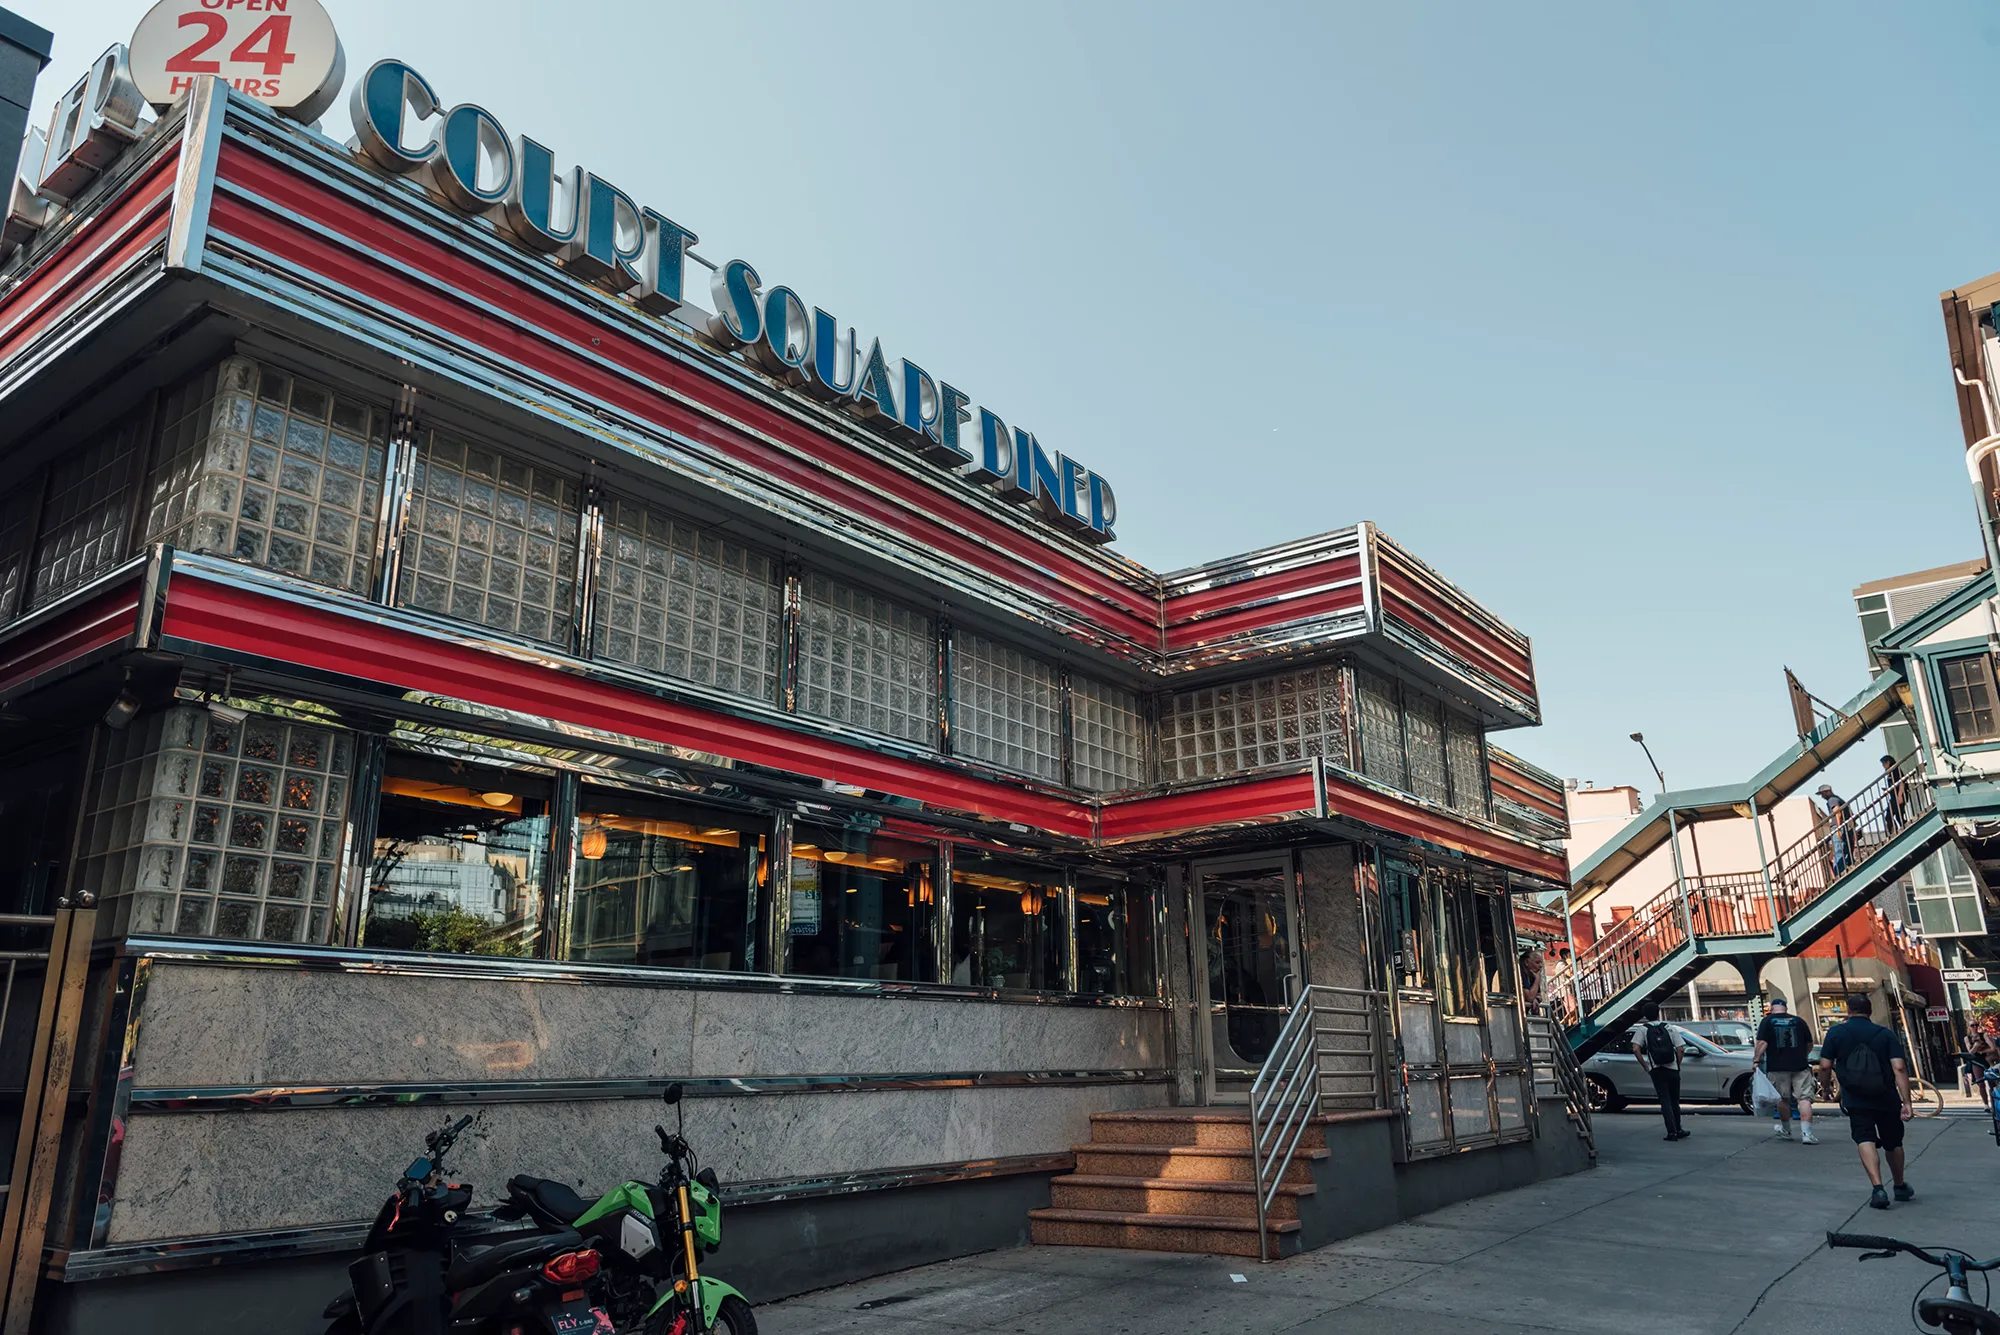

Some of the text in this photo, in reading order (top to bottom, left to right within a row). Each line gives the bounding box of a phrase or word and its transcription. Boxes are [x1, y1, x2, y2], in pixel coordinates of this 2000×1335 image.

[200, 0, 288, 12] OPEN
[165, 11, 296, 75] 24
[169, 76, 281, 98] HRS
[362, 57, 1118, 542] COURT SQUARE DINER
[1927, 1009, 1947, 1017] ATM
[557, 1318, 577, 1330] FLY
